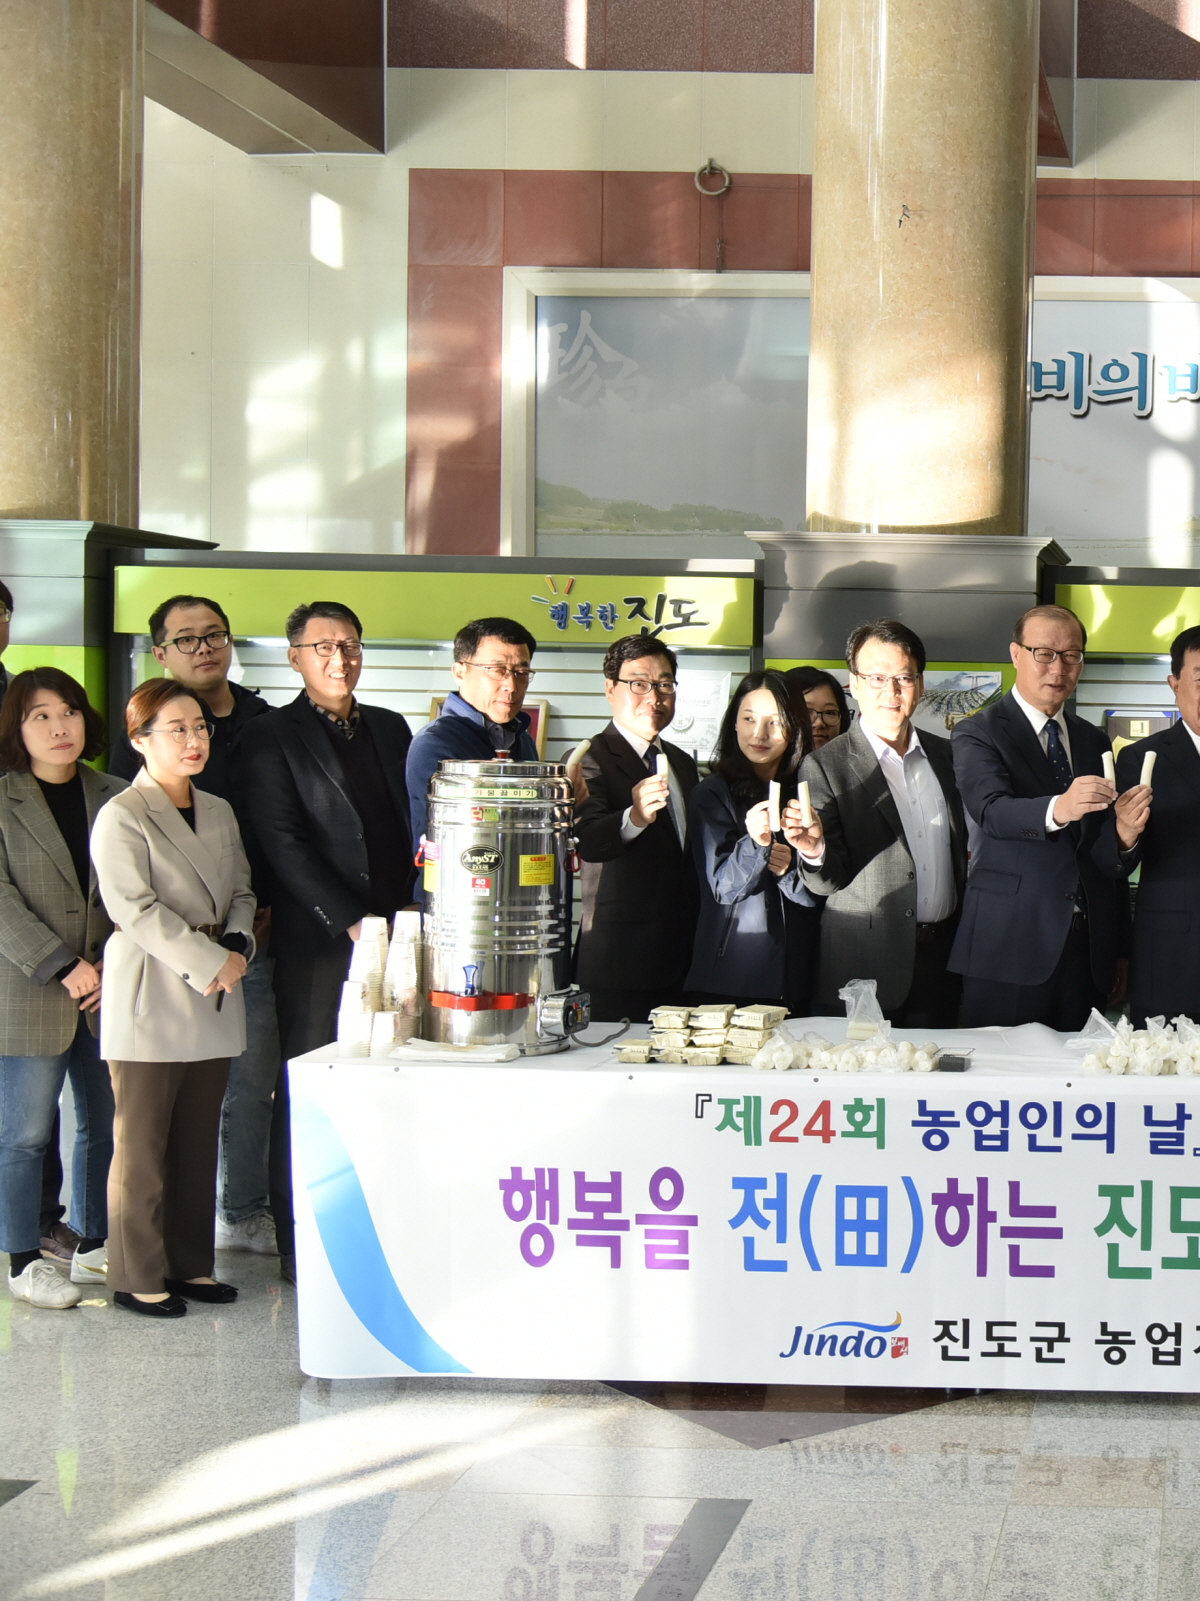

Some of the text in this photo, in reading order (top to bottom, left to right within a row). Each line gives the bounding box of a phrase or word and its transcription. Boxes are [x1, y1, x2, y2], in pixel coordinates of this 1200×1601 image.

[550, 594, 709, 637] 행복한 진도
[694, 1093, 886, 1150] 『제24회
[910, 1099, 1117, 1155] 농업인의
[499, 1166, 699, 1271] 행복을
[727, 1172, 1064, 1279] 전(田)하는
[779, 1325, 888, 1358] Jindo
[932, 1317, 1071, 1364] 진도군
